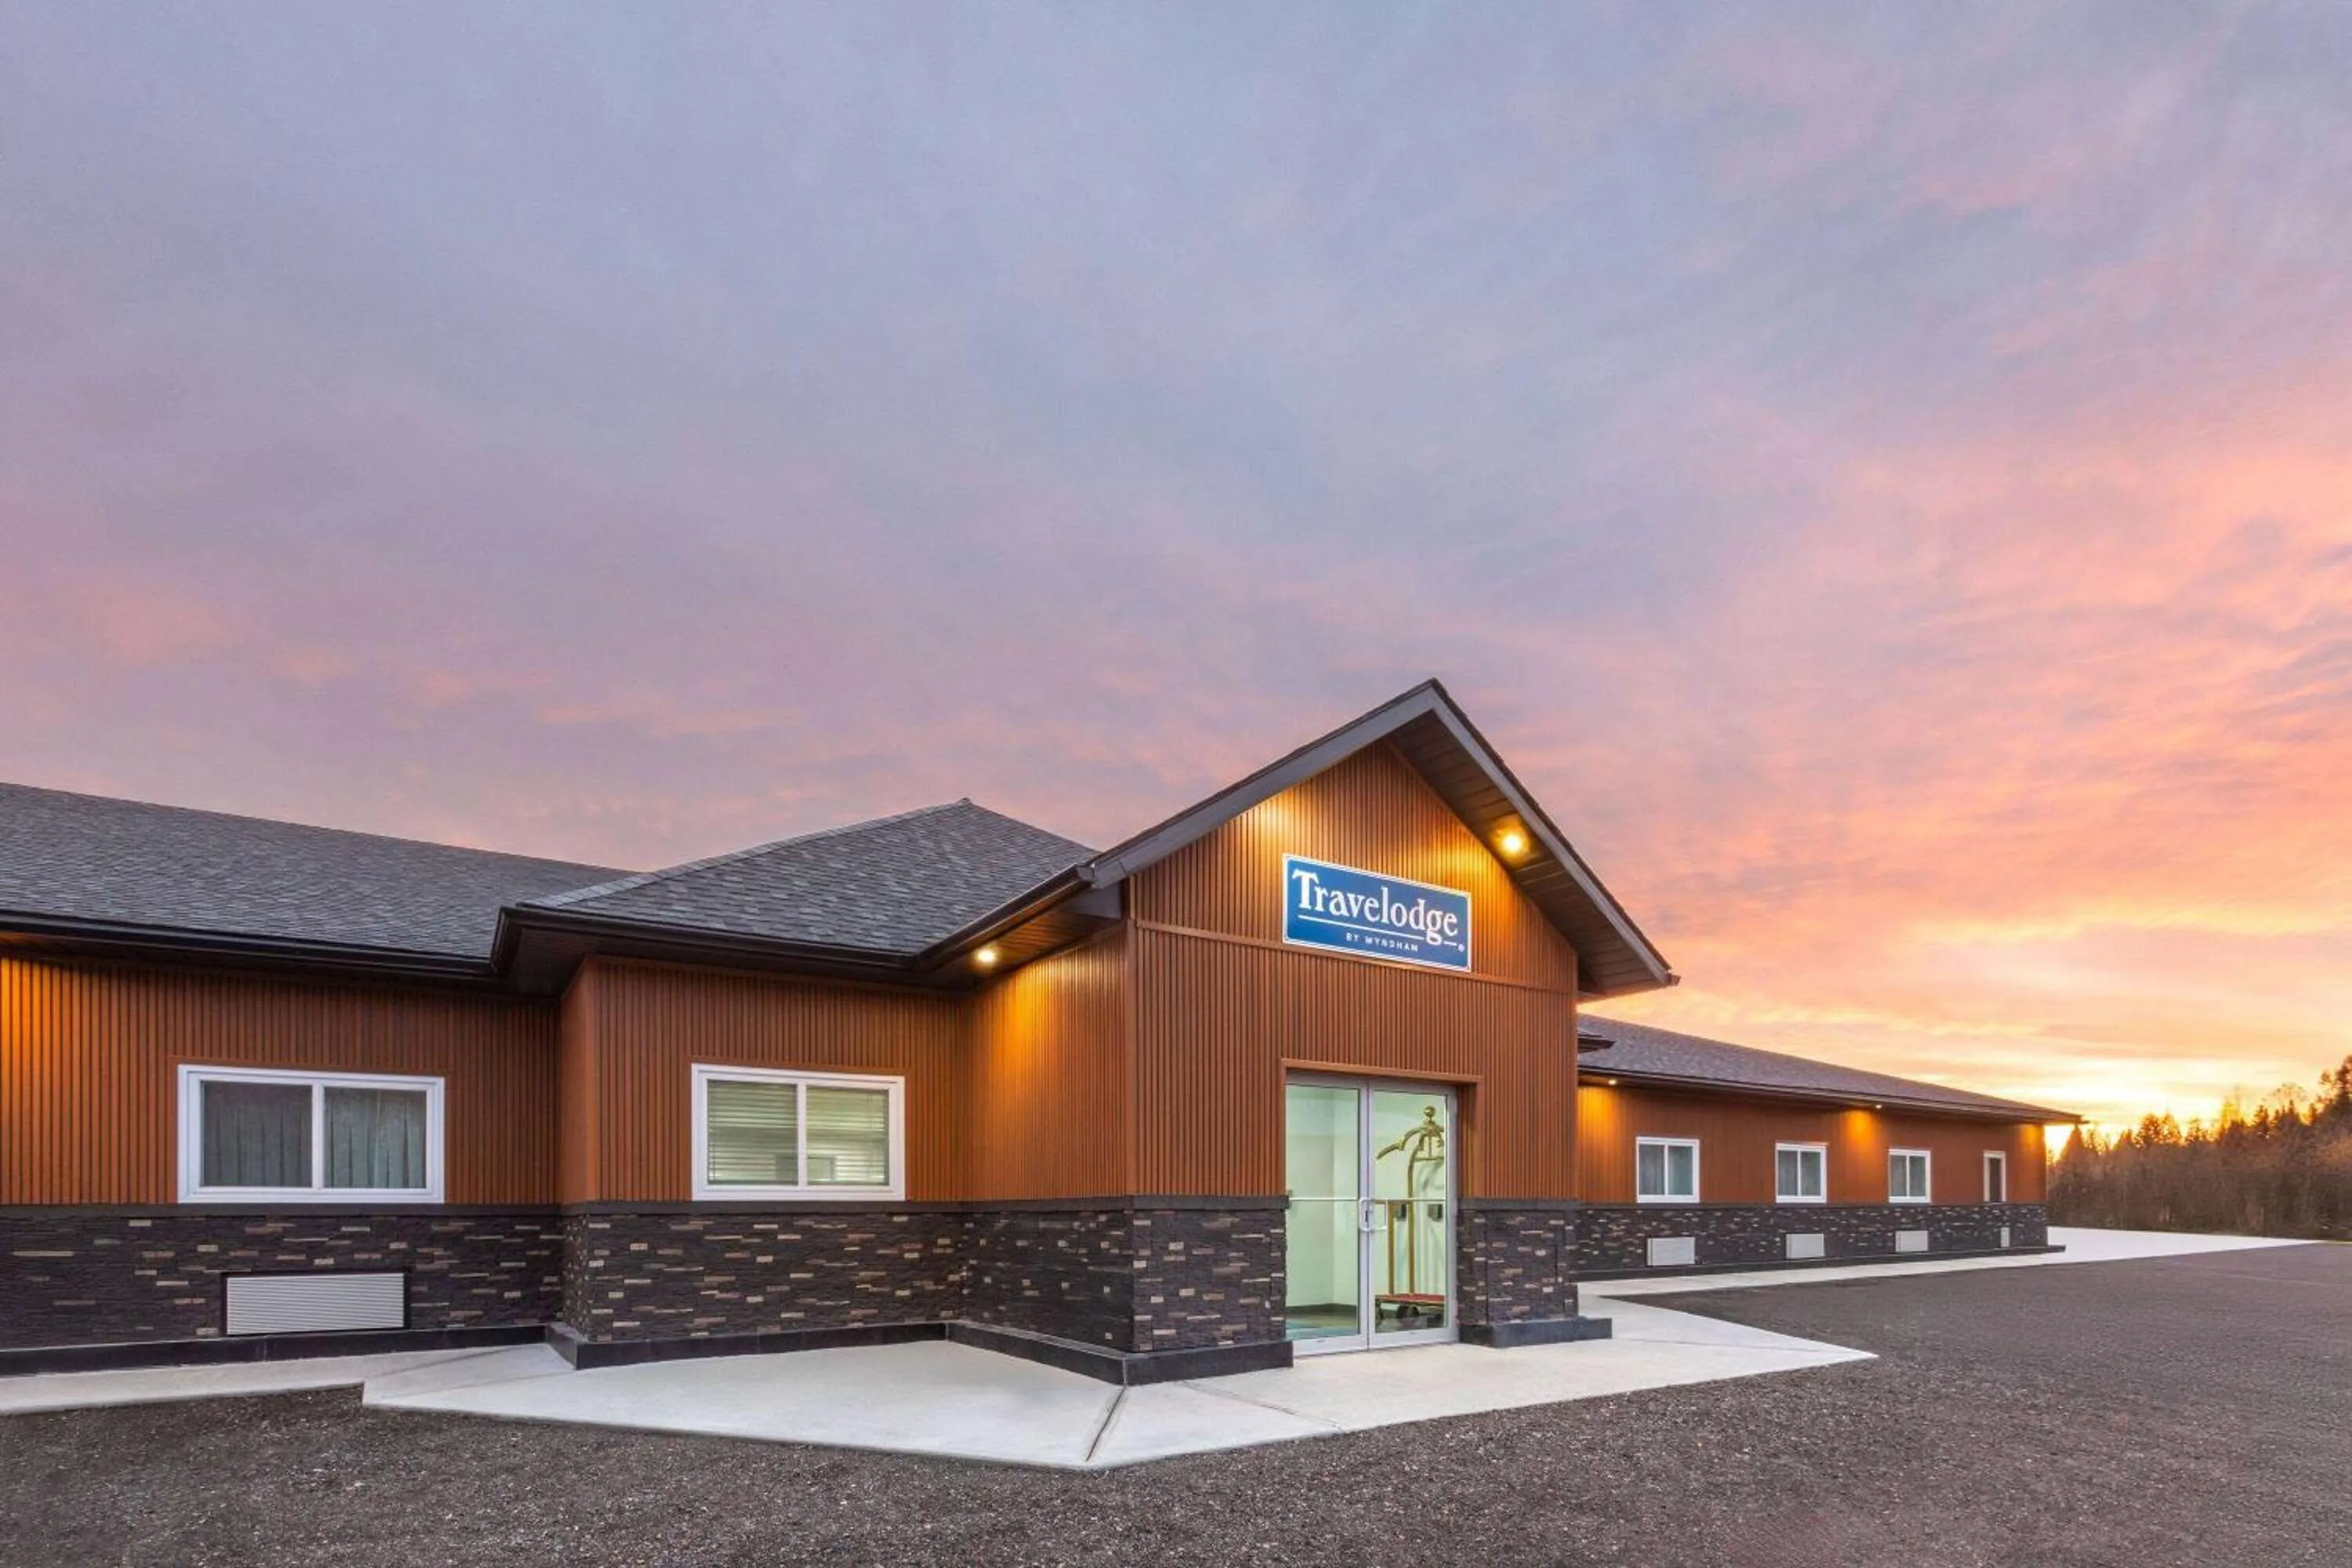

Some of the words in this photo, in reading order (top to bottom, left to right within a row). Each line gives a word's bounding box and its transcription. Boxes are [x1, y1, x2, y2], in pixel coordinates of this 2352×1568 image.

[1292, 869, 1458, 946] Travelodge
[1346, 932, 1359, 942] BY
[1365, 935, 1418, 952] WYNDHAM
